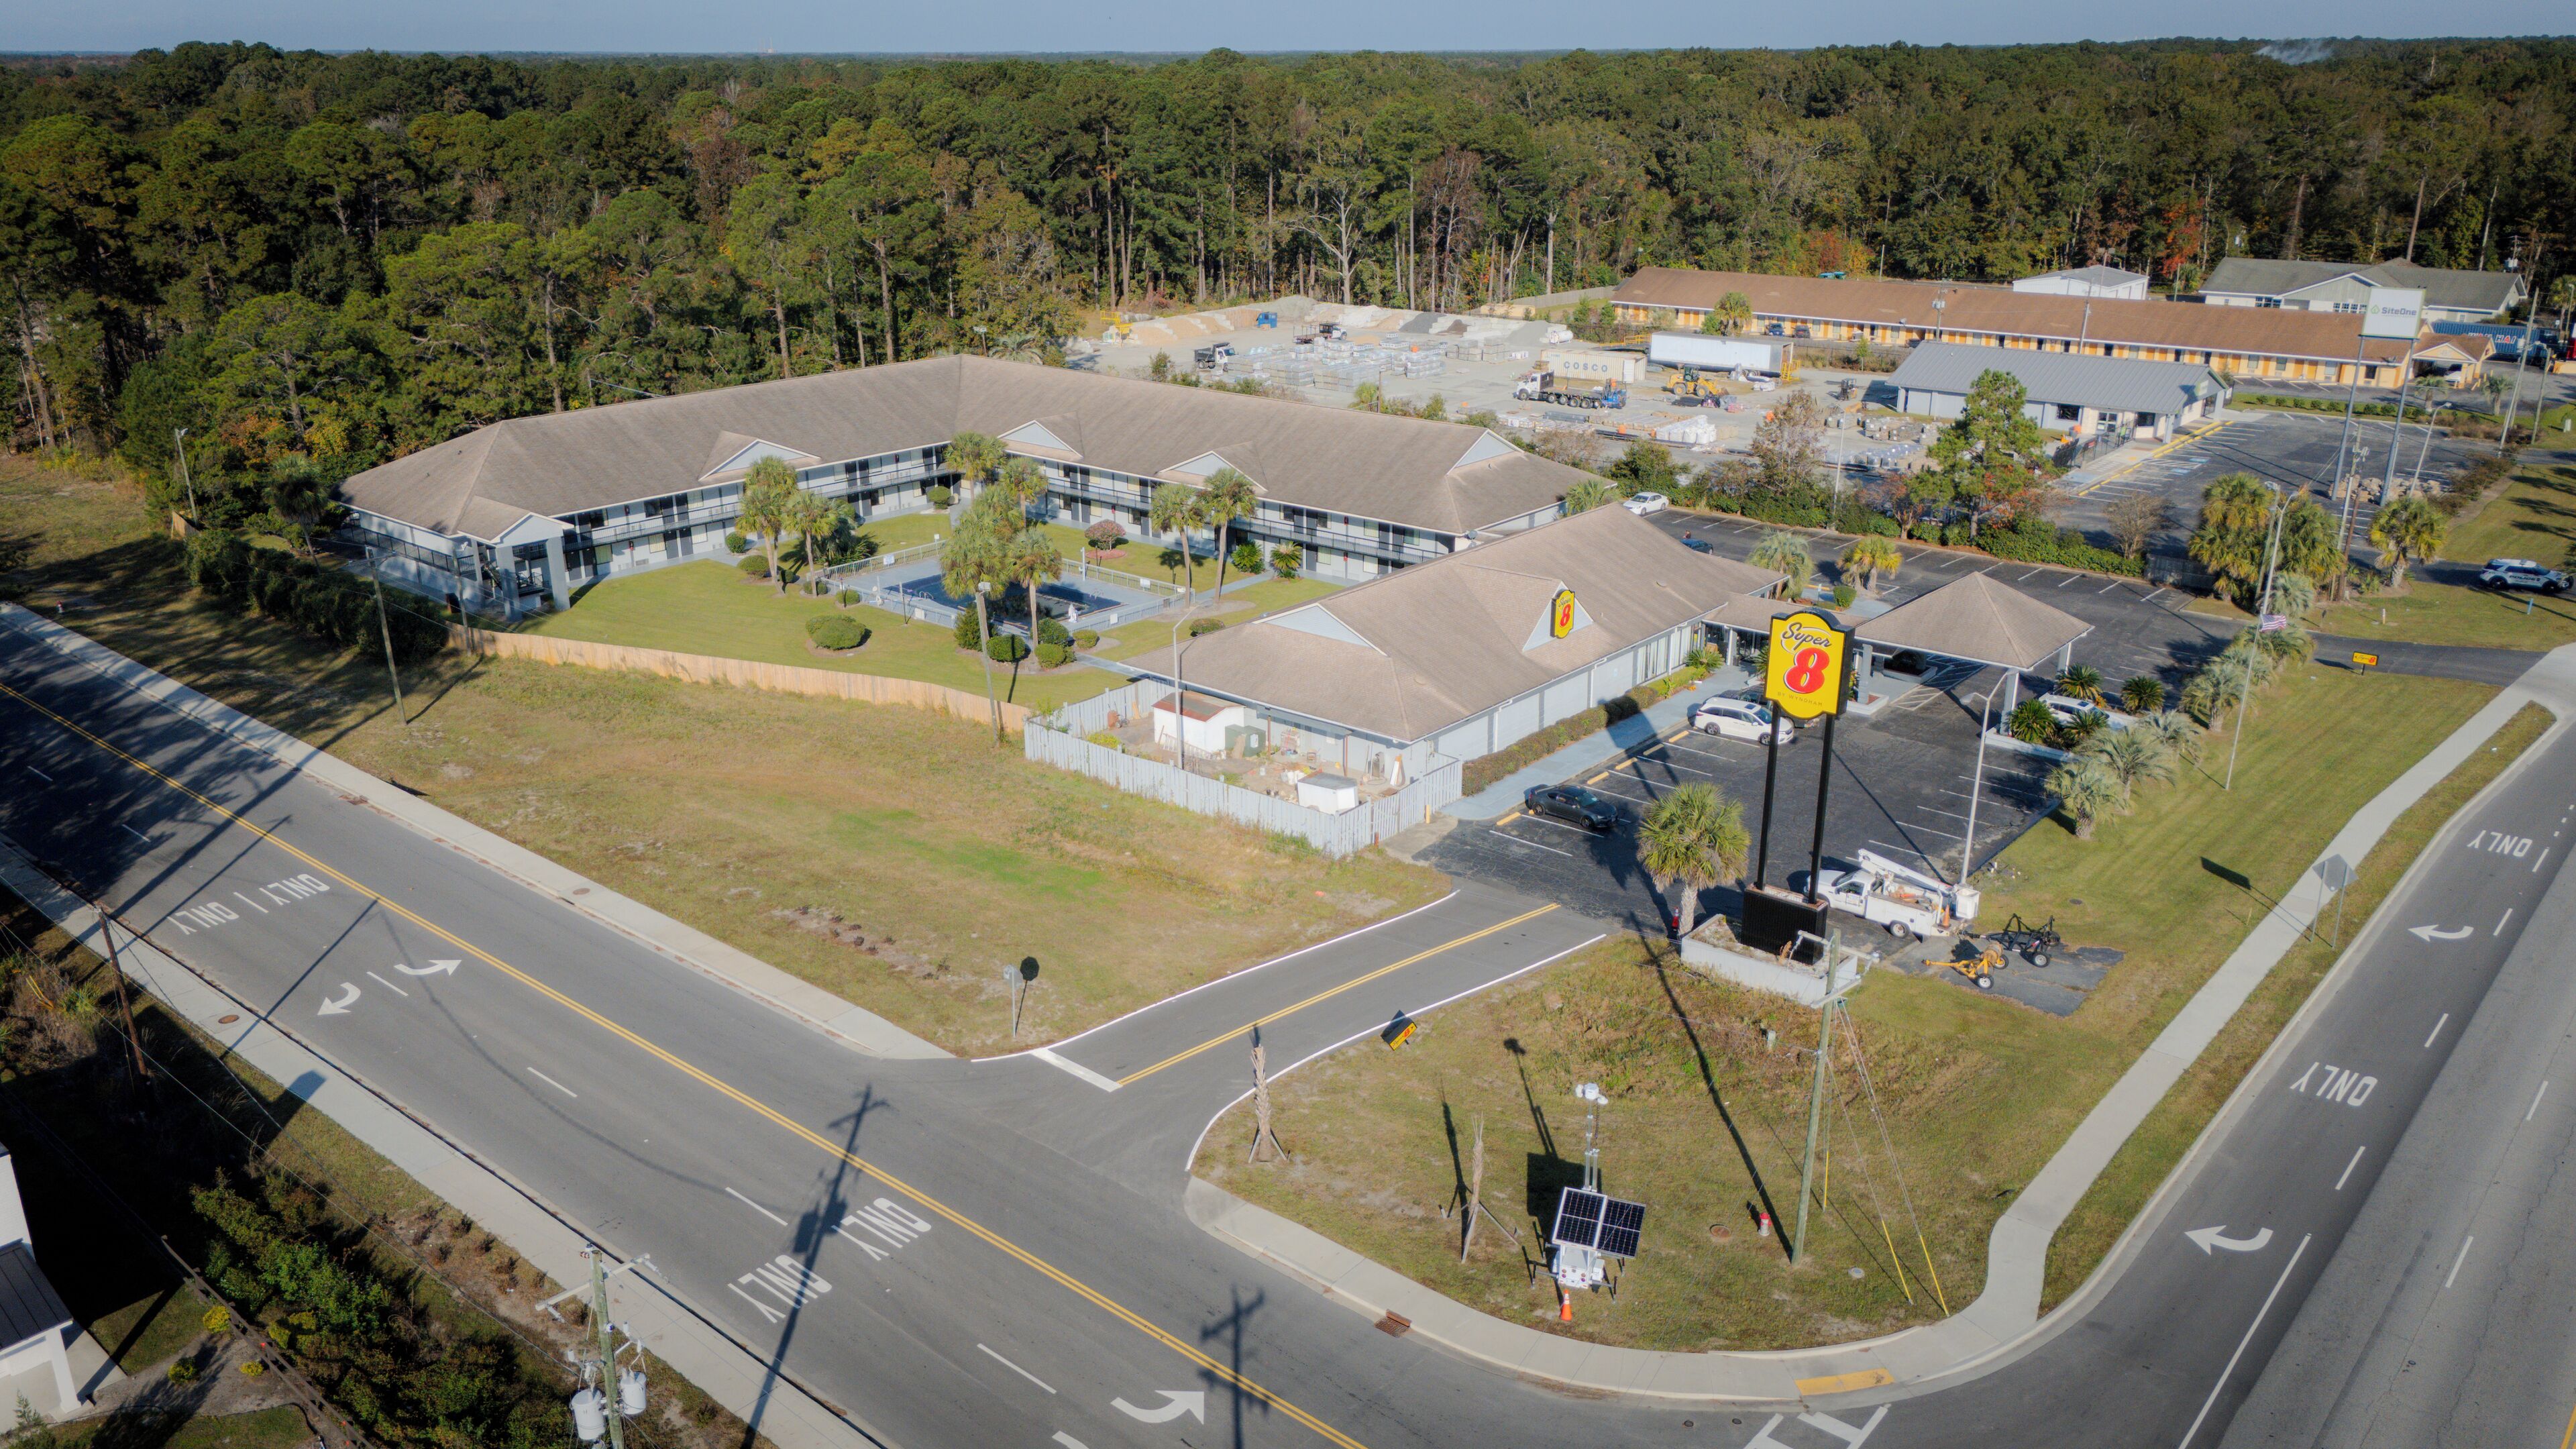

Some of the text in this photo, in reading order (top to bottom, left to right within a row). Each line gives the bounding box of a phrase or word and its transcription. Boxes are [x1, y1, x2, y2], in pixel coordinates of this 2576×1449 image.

[2381, 307, 2417, 315] SiteOne
[2495, 334, 2517, 343] HAI
[1563, 361, 1608, 372] COSCO
[1560, 603, 1572, 627] 8
[1781, 622, 1832, 651] Super
[1784, 647, 1830, 694] 8
[1788, 694, 1823, 707] WYNDHAM
[2467, 830, 2533, 857] ONLY
[259, 873, 330, 906] ONLY
[168, 902, 239, 935] ONLY
[2290, 1062, 2378, 1106] ONLY
[831, 1197, 932, 1261] ONLY
[728, 1254, 832, 1324] ONLY
